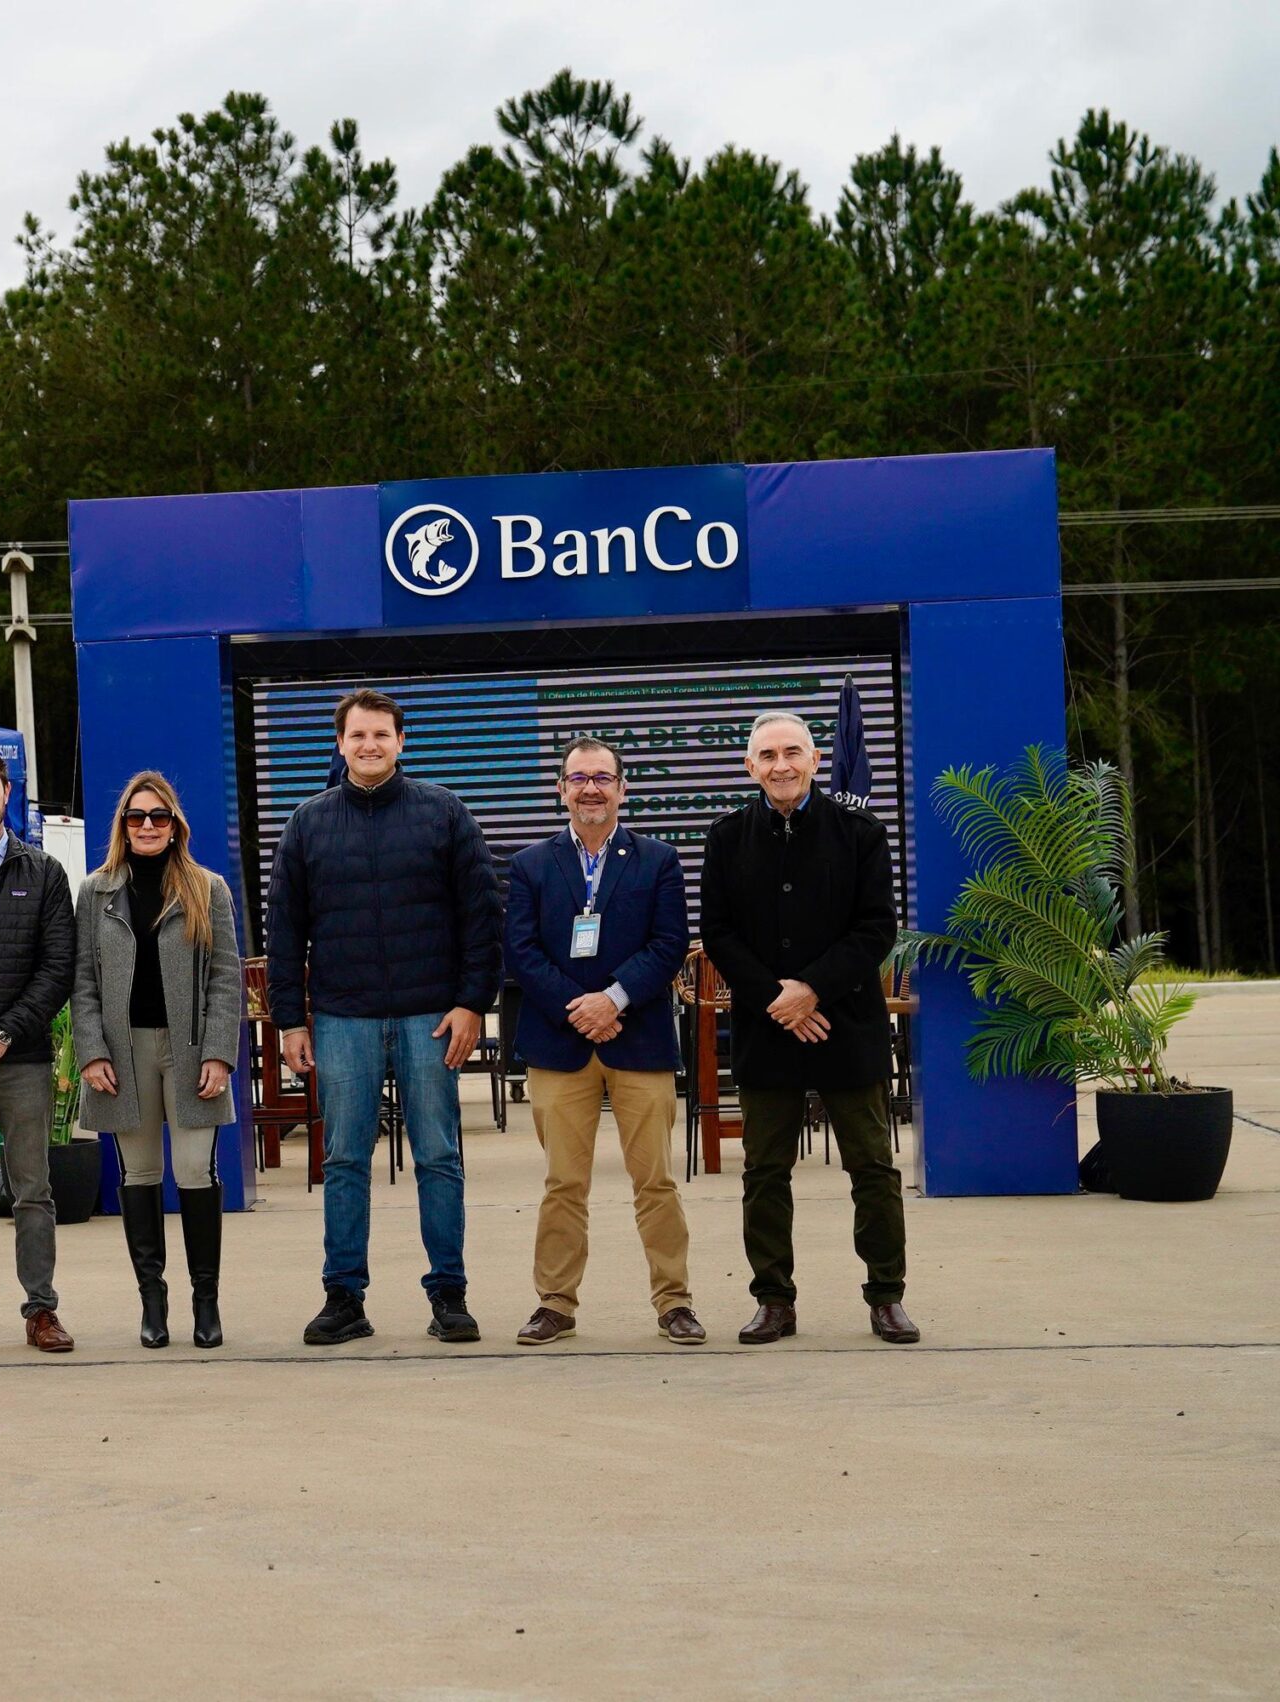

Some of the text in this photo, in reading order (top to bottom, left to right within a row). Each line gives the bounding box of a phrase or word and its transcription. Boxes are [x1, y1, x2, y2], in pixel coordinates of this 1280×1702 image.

[491, 505, 739, 579] BanCo
[649, 726, 688, 748] DE
[698, 720, 839, 745] CREOS
